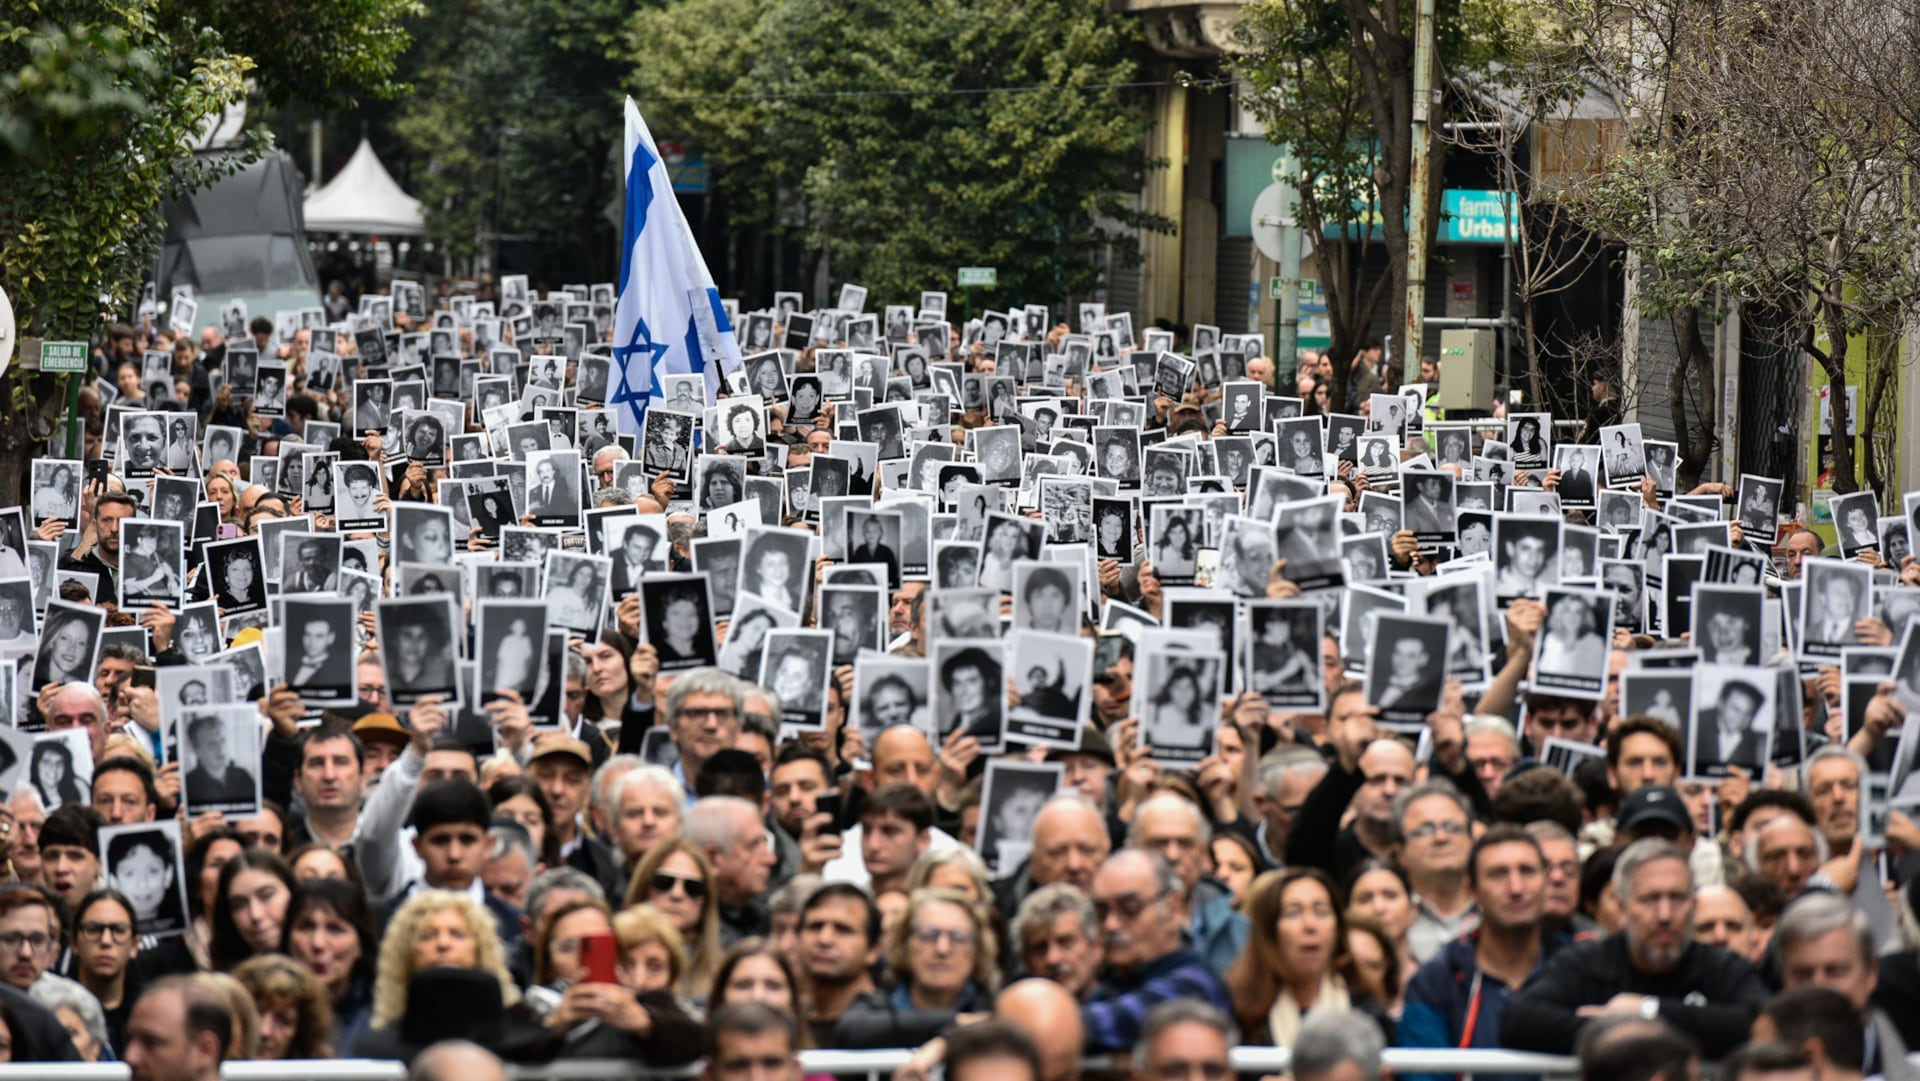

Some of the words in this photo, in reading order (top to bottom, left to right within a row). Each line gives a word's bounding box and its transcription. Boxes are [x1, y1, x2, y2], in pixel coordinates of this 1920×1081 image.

[49, 346, 71, 357] SALIDA
[73, 346, 81, 357] DE
[44, 357, 83, 368] EMERGENCIA
